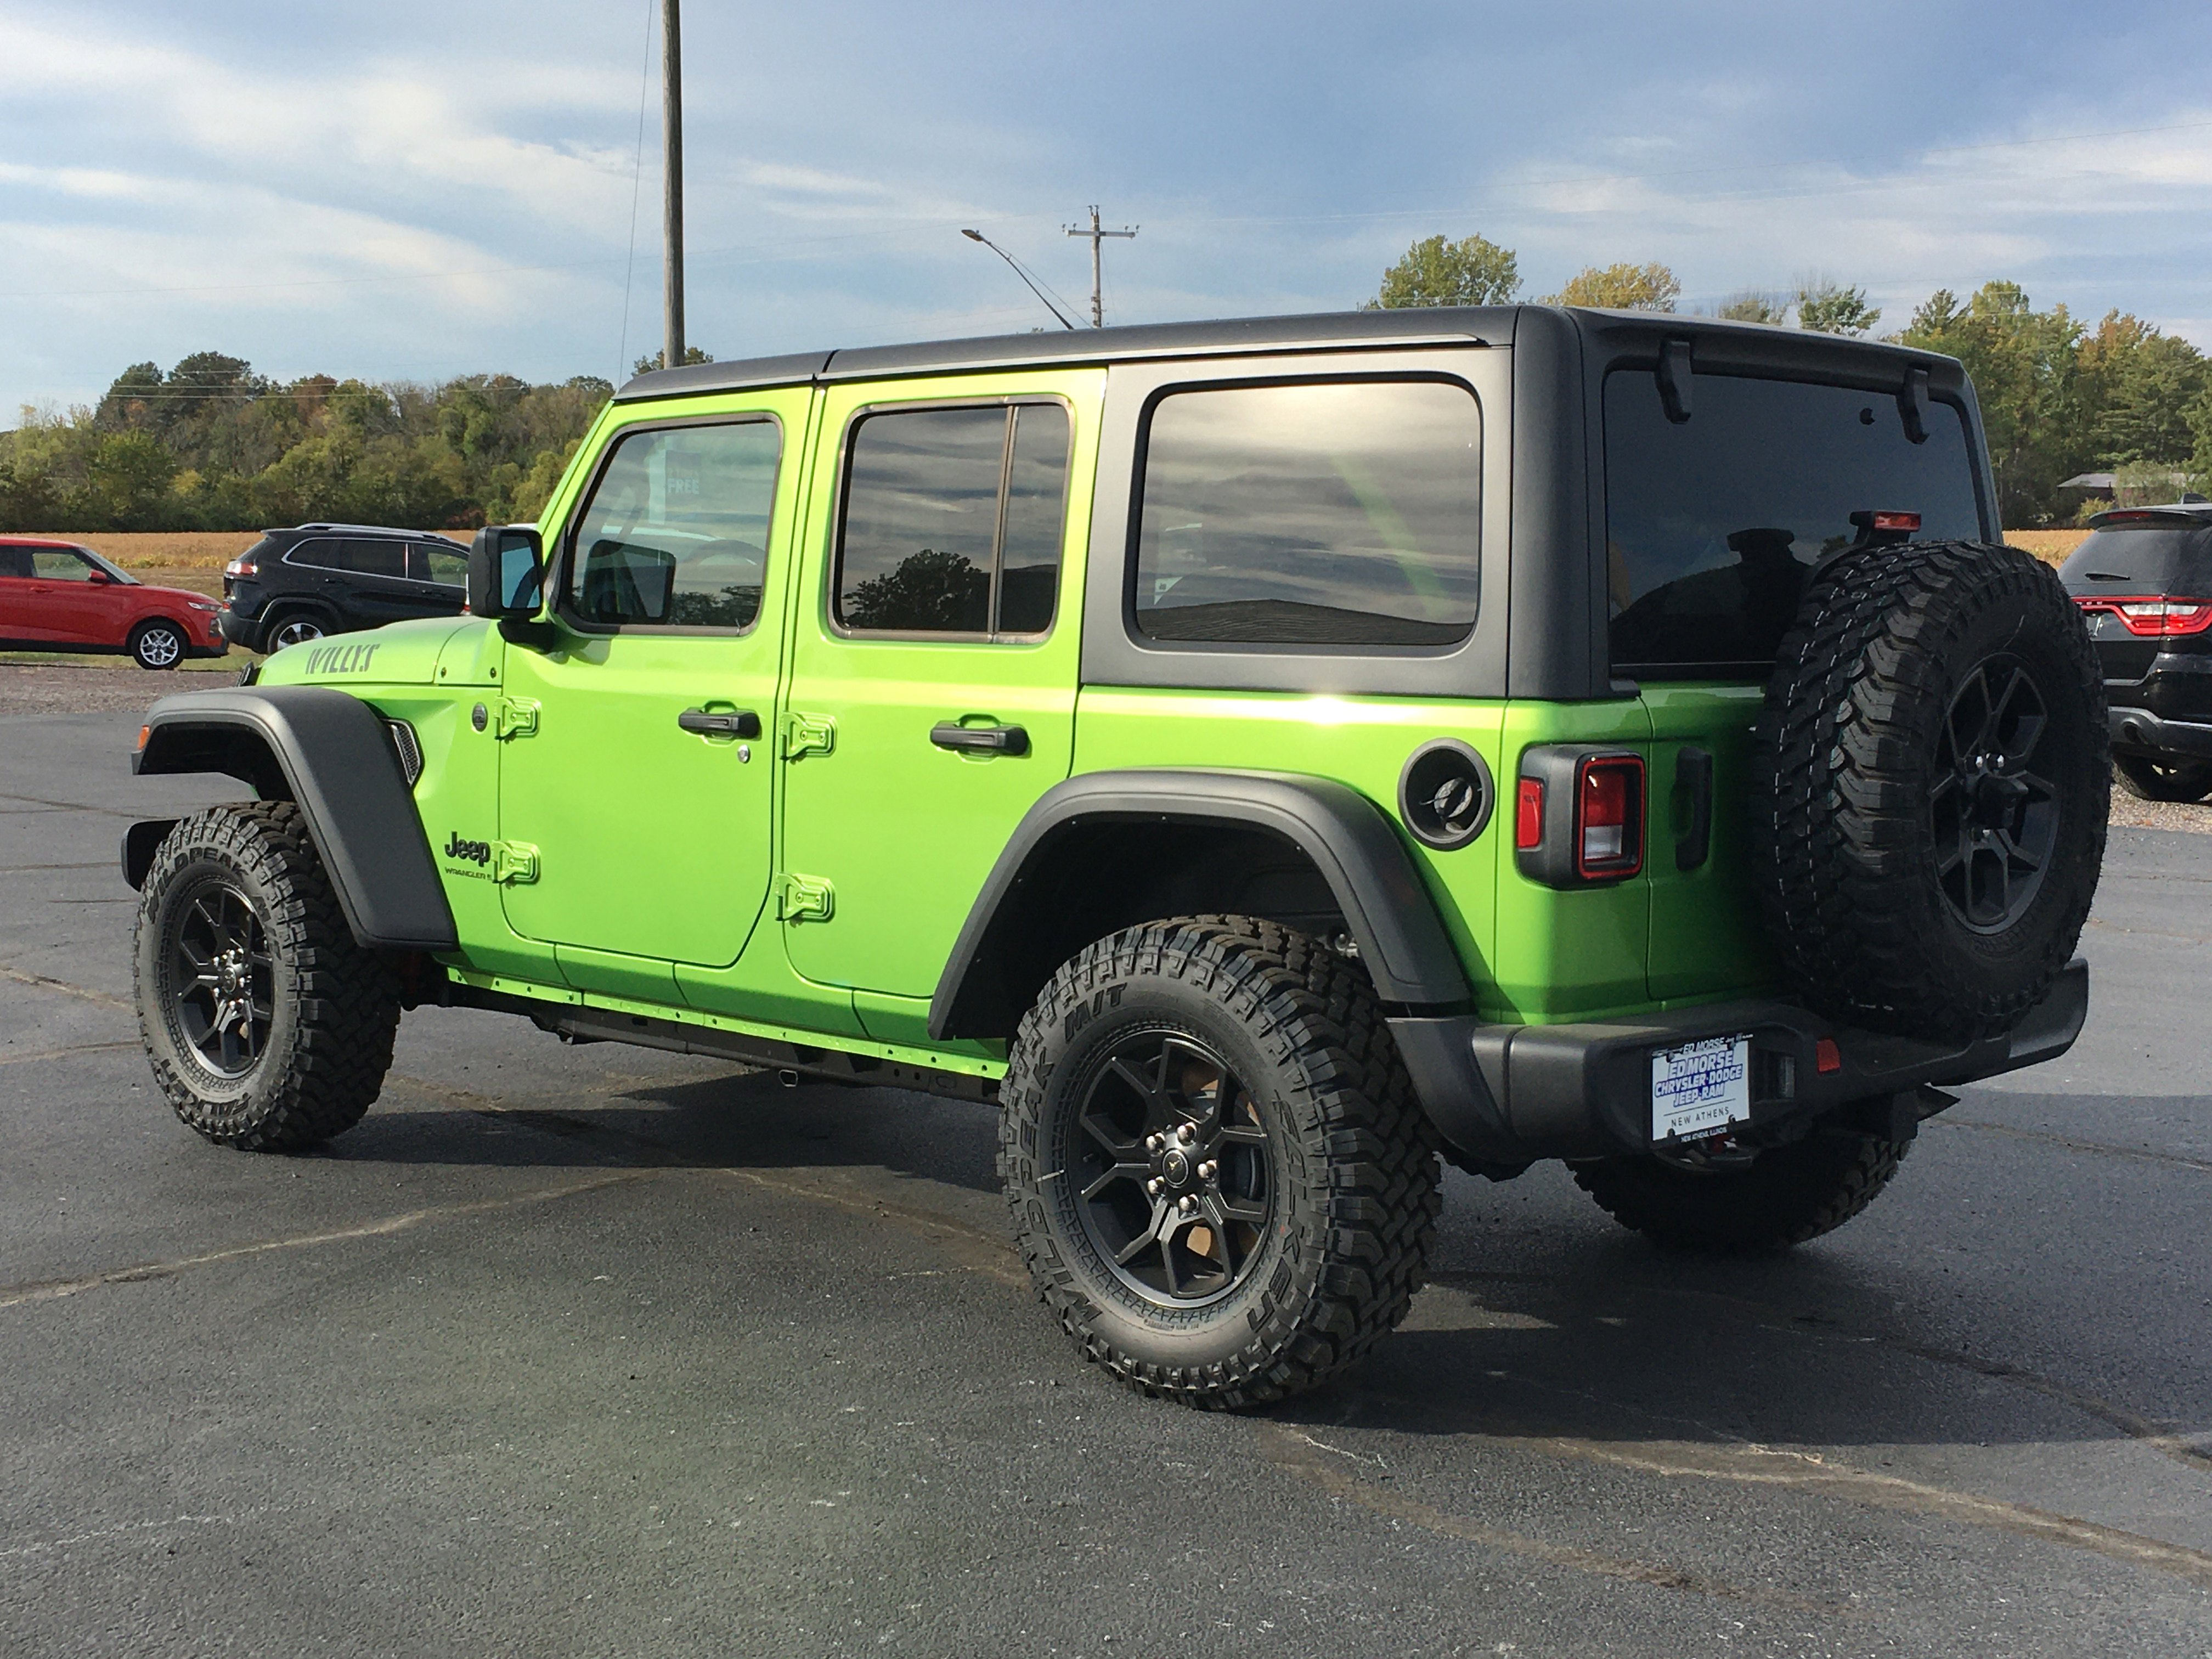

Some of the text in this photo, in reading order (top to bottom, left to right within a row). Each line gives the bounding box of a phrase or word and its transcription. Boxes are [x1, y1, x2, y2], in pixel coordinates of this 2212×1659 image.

[667, 478, 699, 494] FREE
[305, 644, 381, 675] WILLYS
[444, 831, 491, 867] Jeep
[445, 867, 486, 879] WRANGLER
[1683, 1042, 1695, 1054] ED
[1696, 1037, 1725, 1052] MORSE
[1668, 1049, 1734, 1079] ED MORSE
[1671, 1106, 1729, 1127] NEW ATHENS
